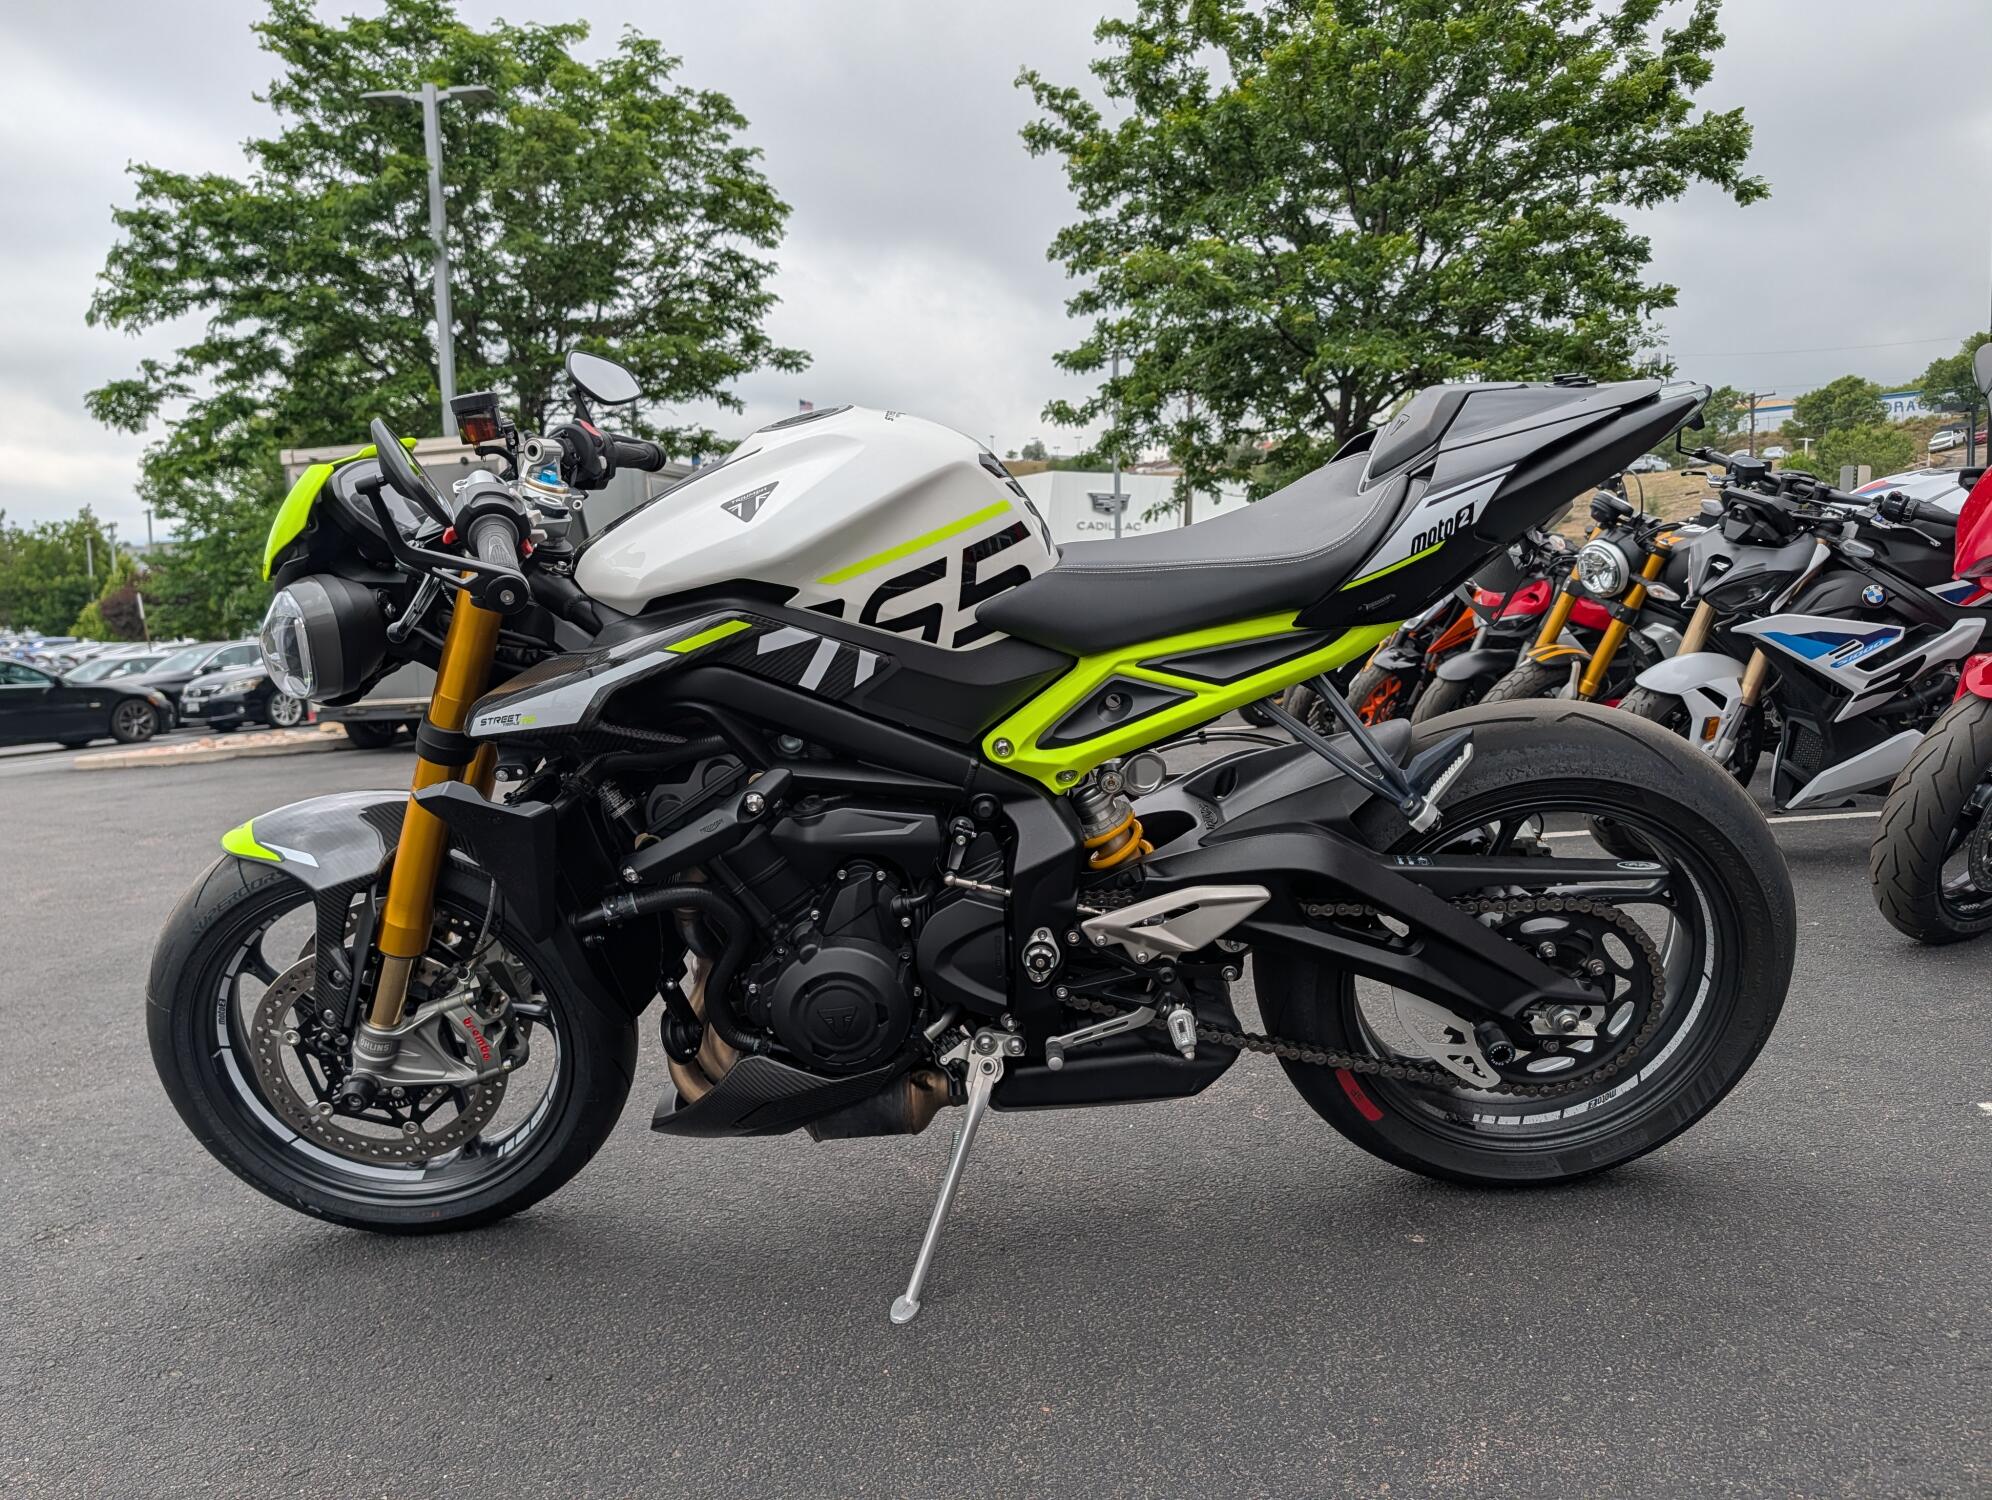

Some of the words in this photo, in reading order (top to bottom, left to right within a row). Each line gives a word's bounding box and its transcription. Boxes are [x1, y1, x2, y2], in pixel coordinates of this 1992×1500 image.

[1076, 521, 1141, 531] CADILAC
[1410, 501, 1475, 557] moto2
[480, 713, 522, 727] STREET
[463, 1015, 491, 1062] brembo
